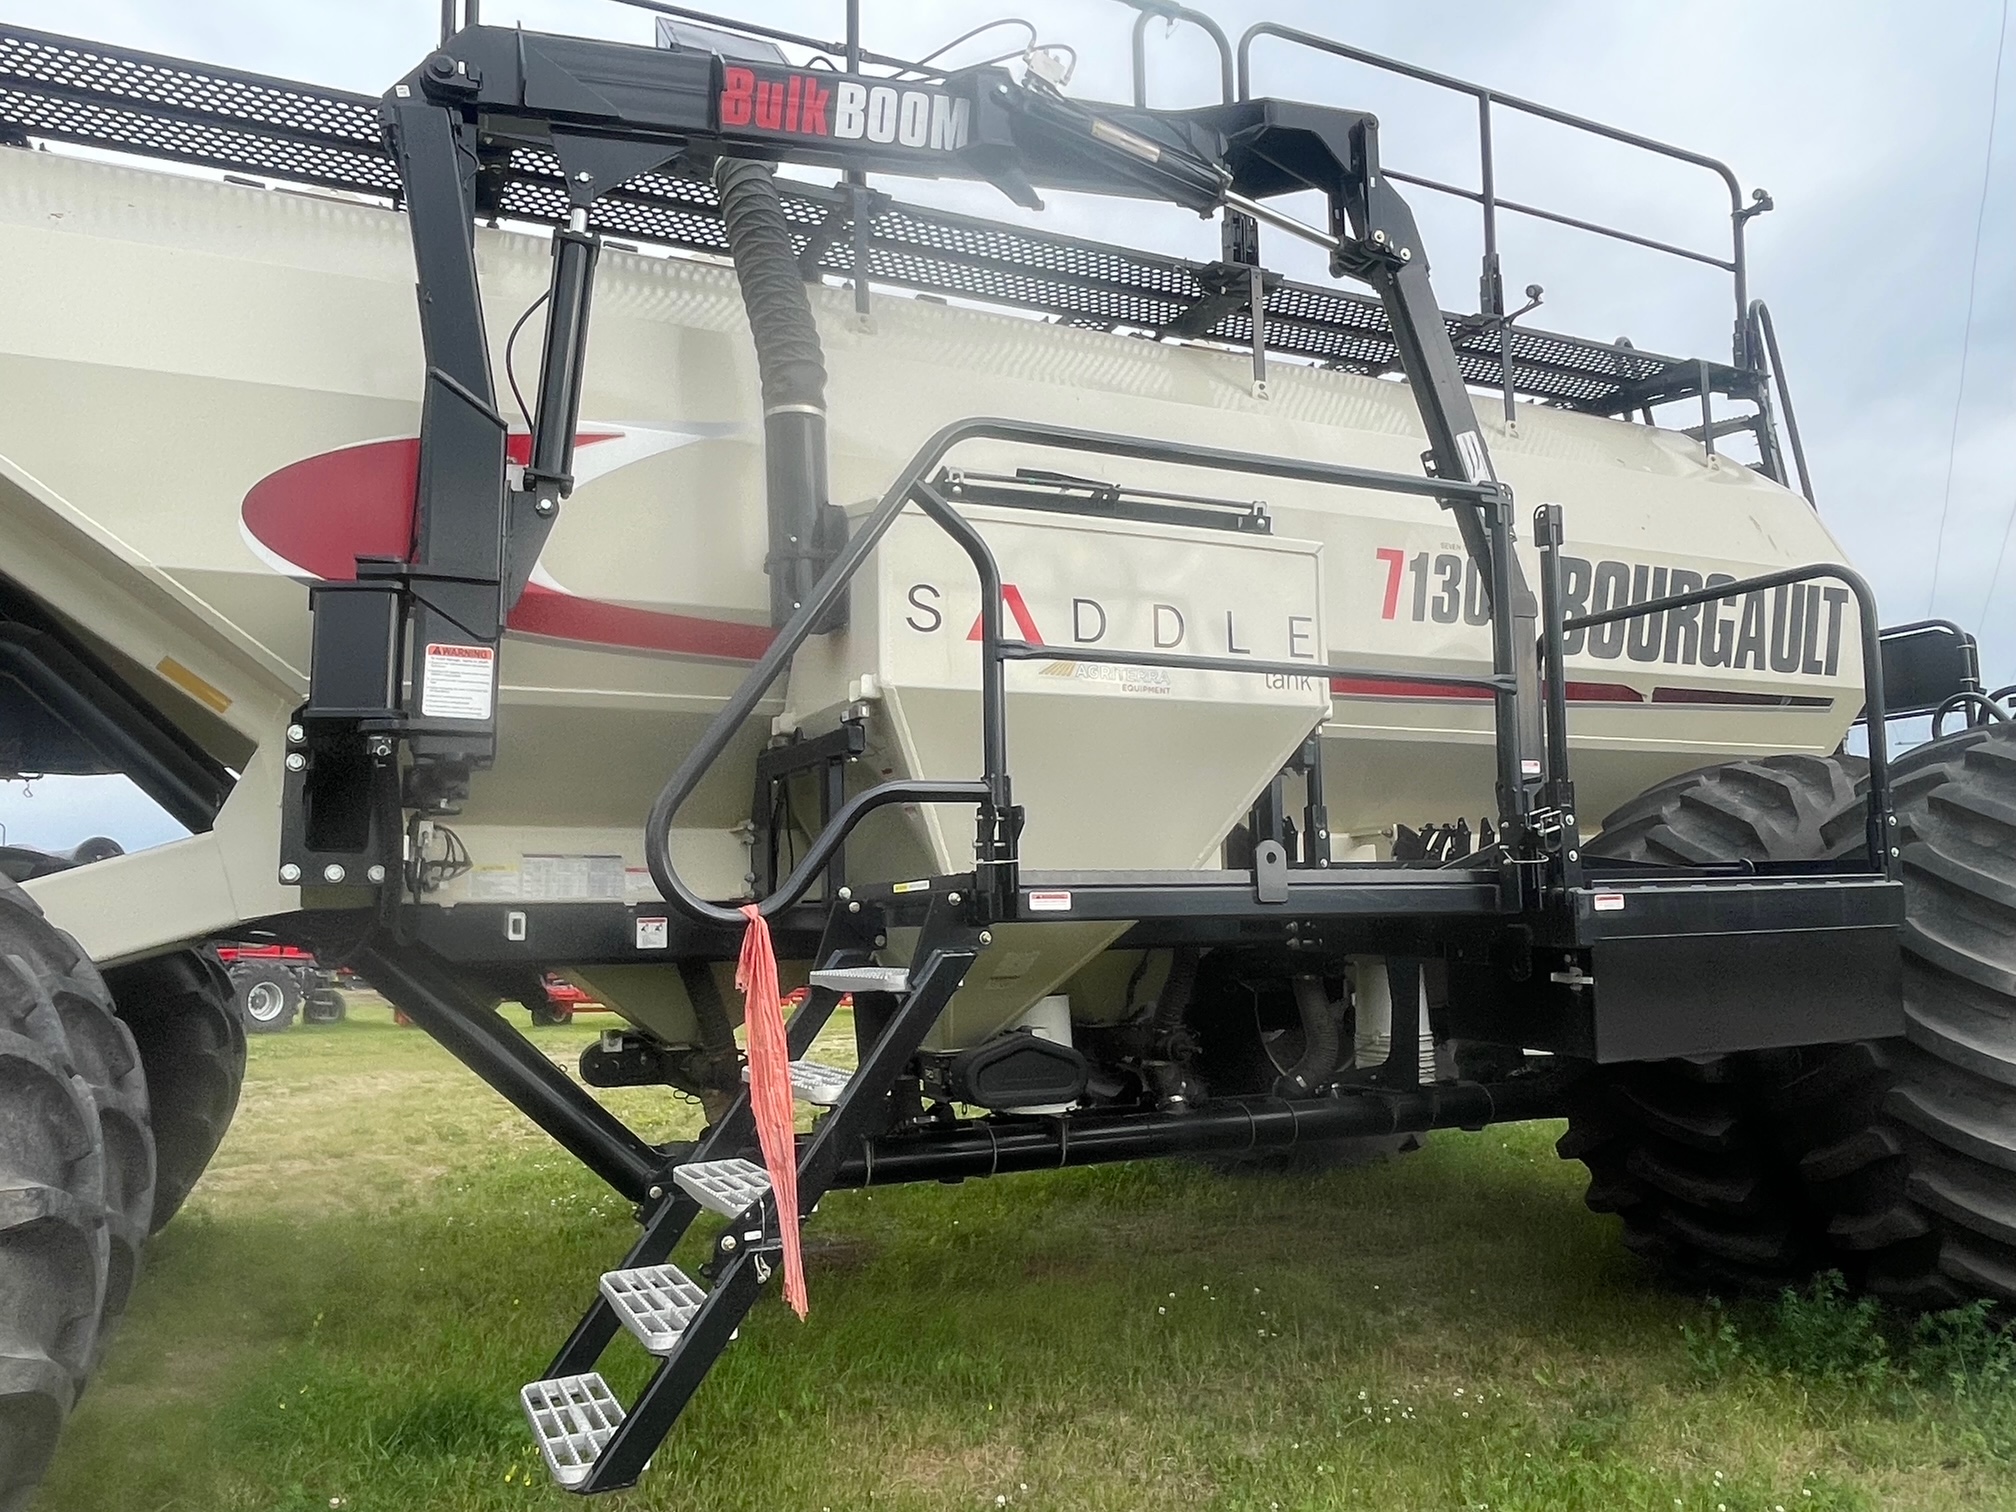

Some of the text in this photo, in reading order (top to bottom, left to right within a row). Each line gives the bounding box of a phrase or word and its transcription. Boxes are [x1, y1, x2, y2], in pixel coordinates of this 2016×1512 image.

[1560, 556, 1849, 676] BOURGAULT
[442, 647, 488, 659] WARNING
[1075, 663, 1171, 685] AGRITERRA
[1122, 684, 1171, 695] EQUIPMENT
